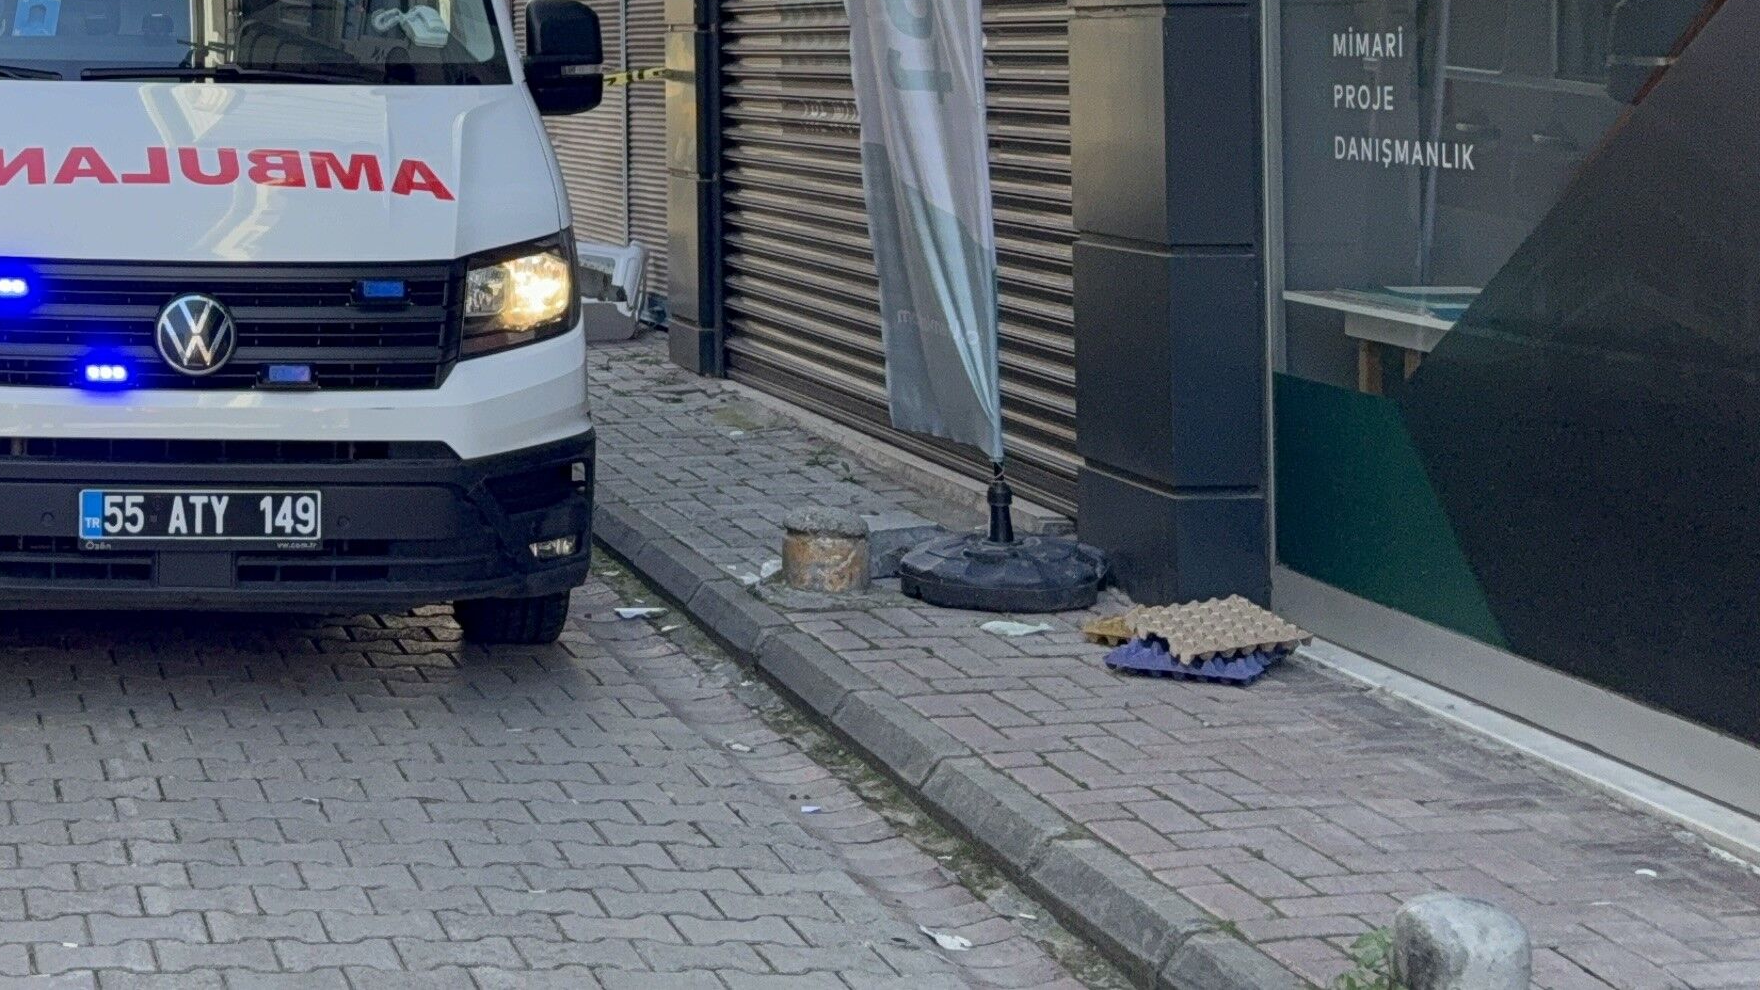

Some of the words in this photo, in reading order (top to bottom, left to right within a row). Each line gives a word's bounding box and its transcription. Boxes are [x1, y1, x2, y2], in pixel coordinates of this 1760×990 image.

[1332, 25, 1405, 60] MİMARİ
[1333, 84, 1394, 111] PROJE
[1333, 136, 1476, 170] DANIŞMANLIK
[84, 517, 100, 529] TR
[103, 495, 145, 534] 55
[167, 495, 229, 534] ATY
[259, 495, 316, 534] 149
